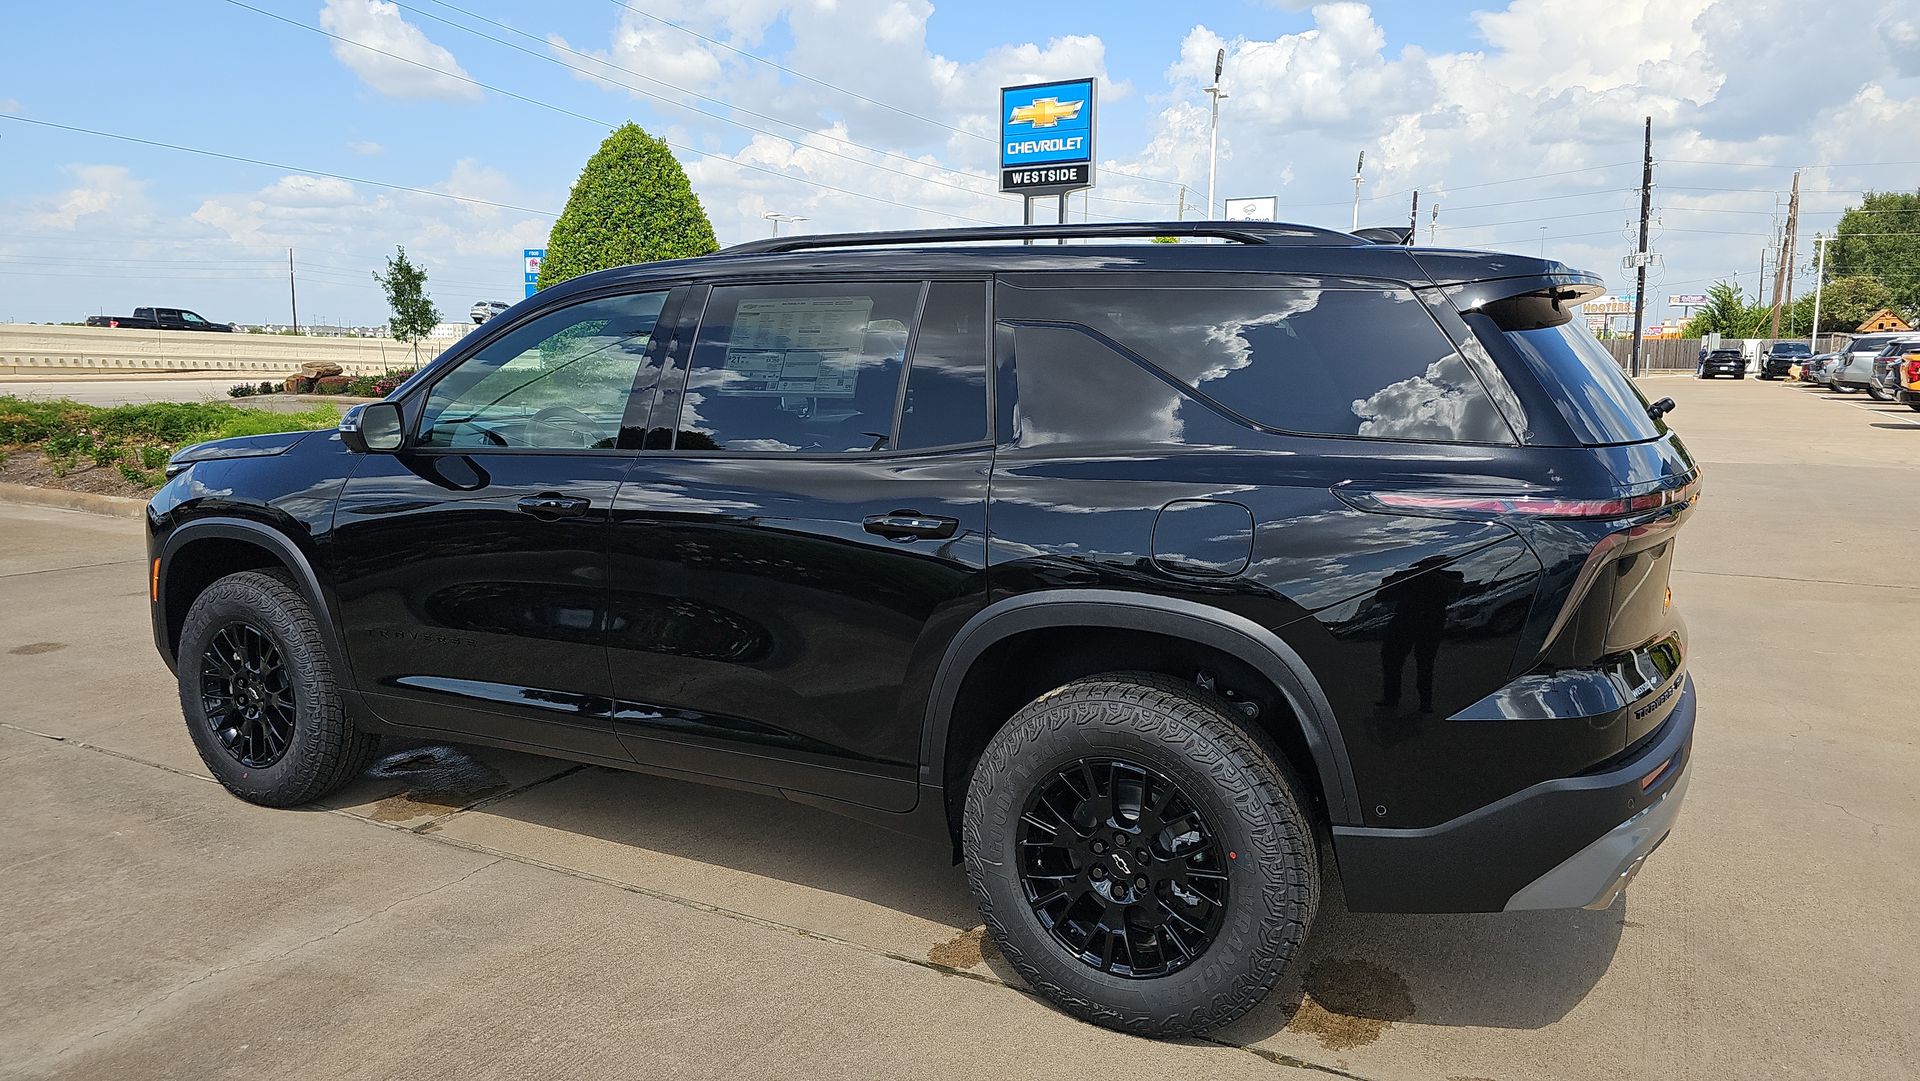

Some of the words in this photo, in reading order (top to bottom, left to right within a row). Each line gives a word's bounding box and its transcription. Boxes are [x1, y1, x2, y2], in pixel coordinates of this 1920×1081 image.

[1007, 136, 1084, 154] CHEVROLET
[1012, 168, 1078, 184] WESTSIDE
[1582, 302, 1630, 313] HOOTERS
[366, 629, 478, 648] TRAVERSE
